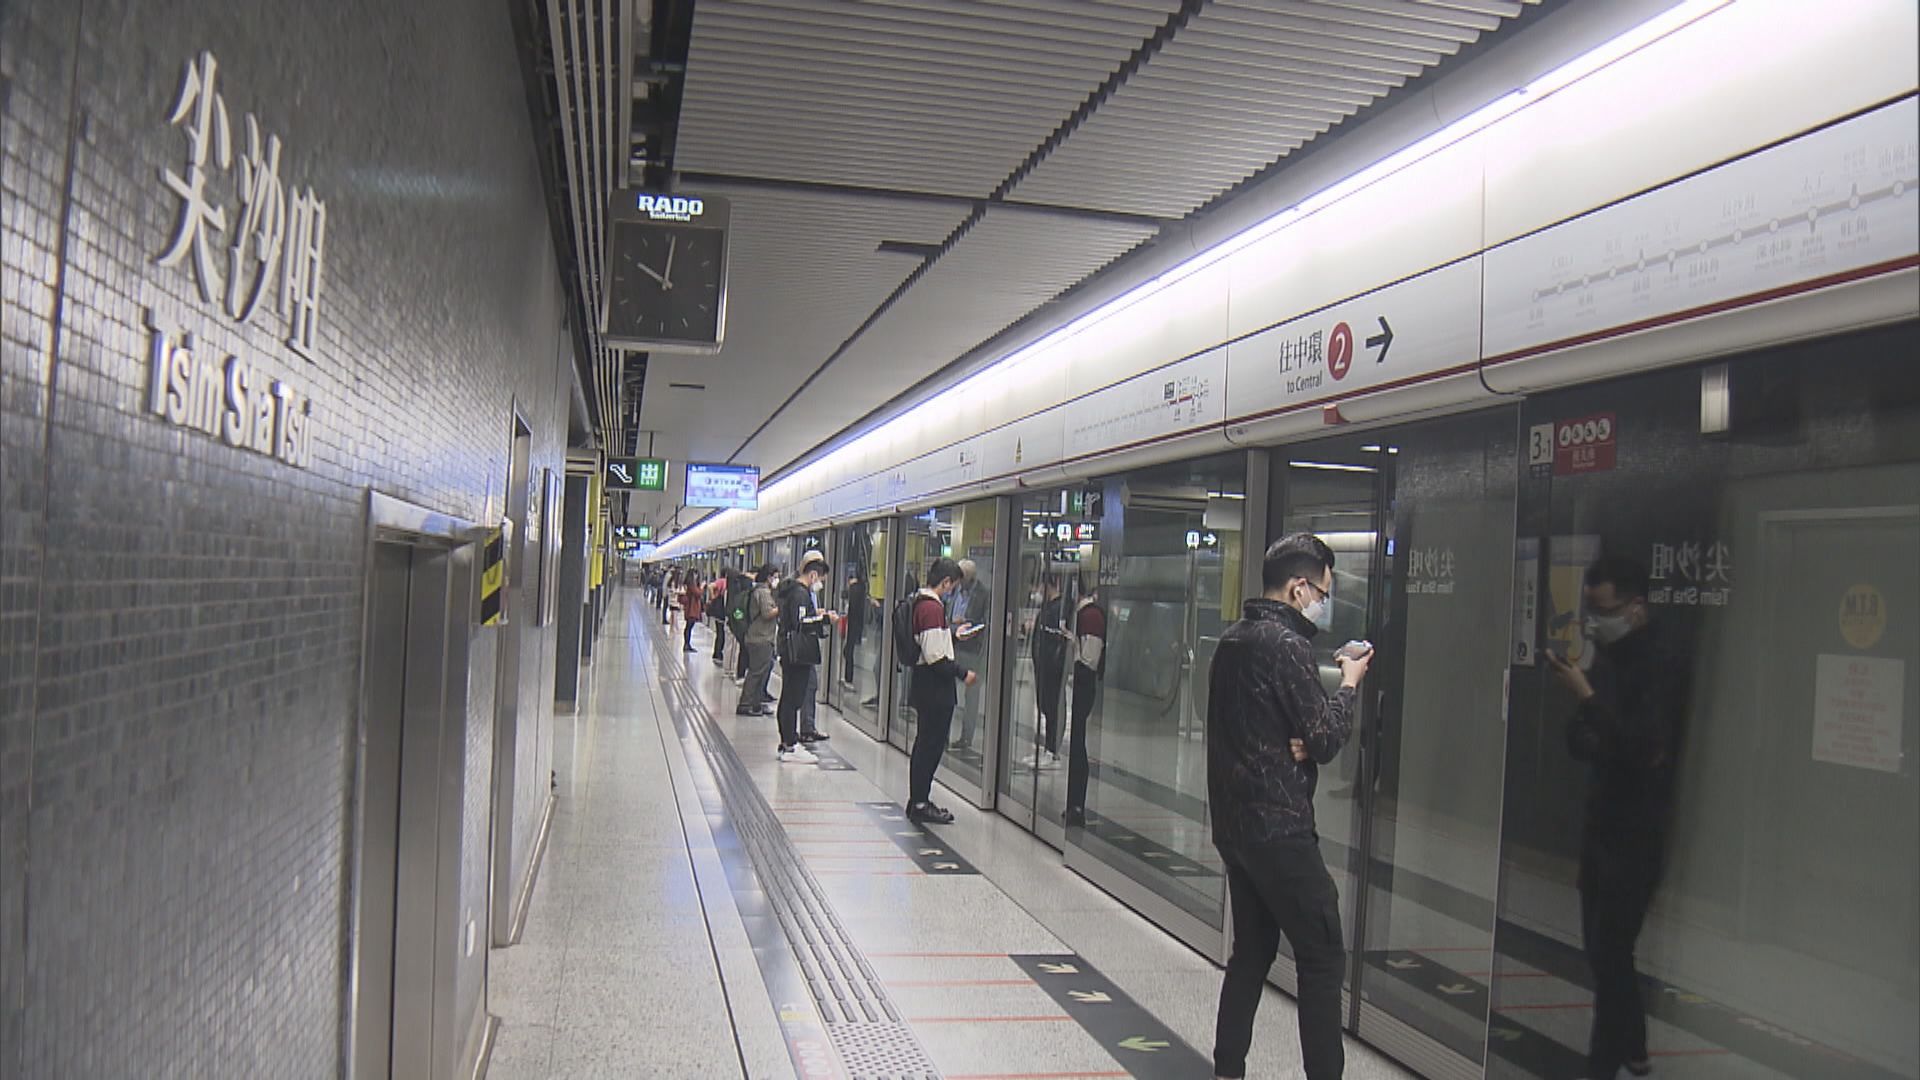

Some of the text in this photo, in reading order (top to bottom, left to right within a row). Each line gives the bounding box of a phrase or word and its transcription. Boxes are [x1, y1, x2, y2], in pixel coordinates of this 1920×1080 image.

[155, 50, 326, 364] 尖沙咀
[638, 194, 703, 215] RADO
[1279, 330, 1322, 374] 往中環
[1334, 332, 1346, 371] 2
[145, 305, 313, 468] Tsim Sha Tsui
[1287, 370, 1322, 395] to Central
[640, 478, 657, 487] EXIT
